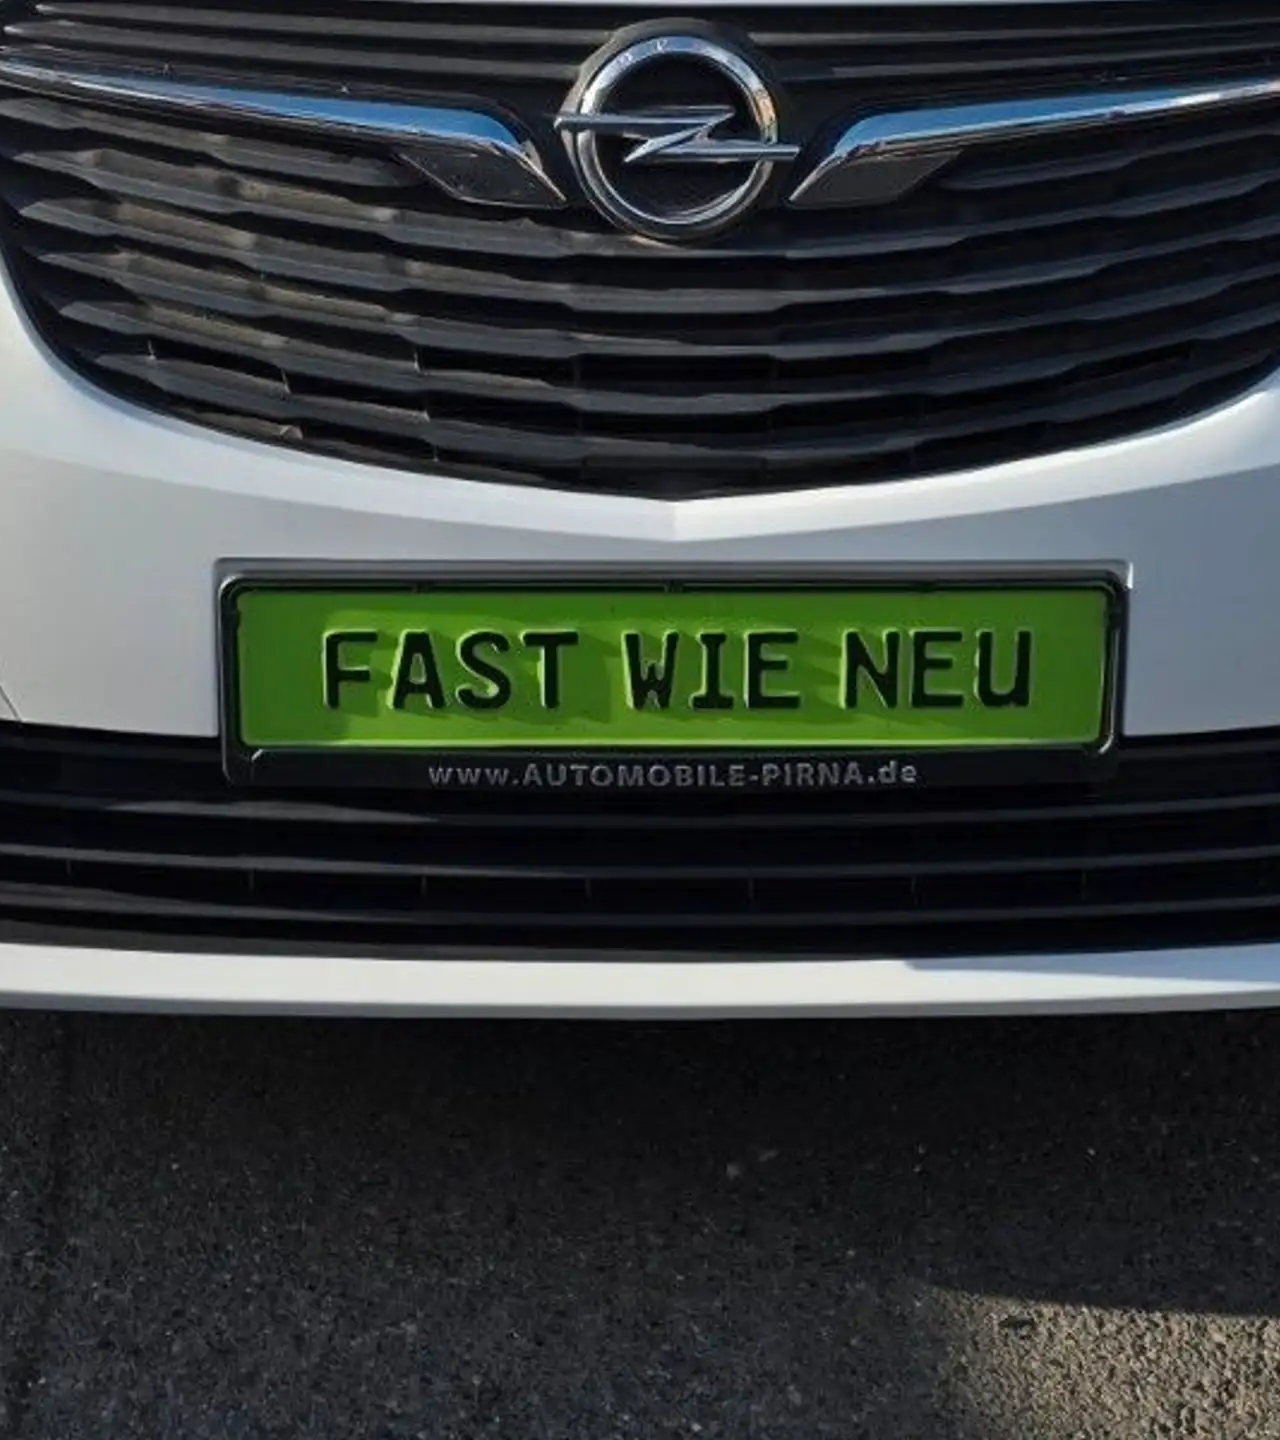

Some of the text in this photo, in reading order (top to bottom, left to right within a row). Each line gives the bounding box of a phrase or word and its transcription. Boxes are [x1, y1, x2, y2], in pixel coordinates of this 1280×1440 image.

[323, 628, 1032, 710] FAST WIE NEU
[427, 760, 918, 787] www.AUTOMOBILE-PIRNA.de
